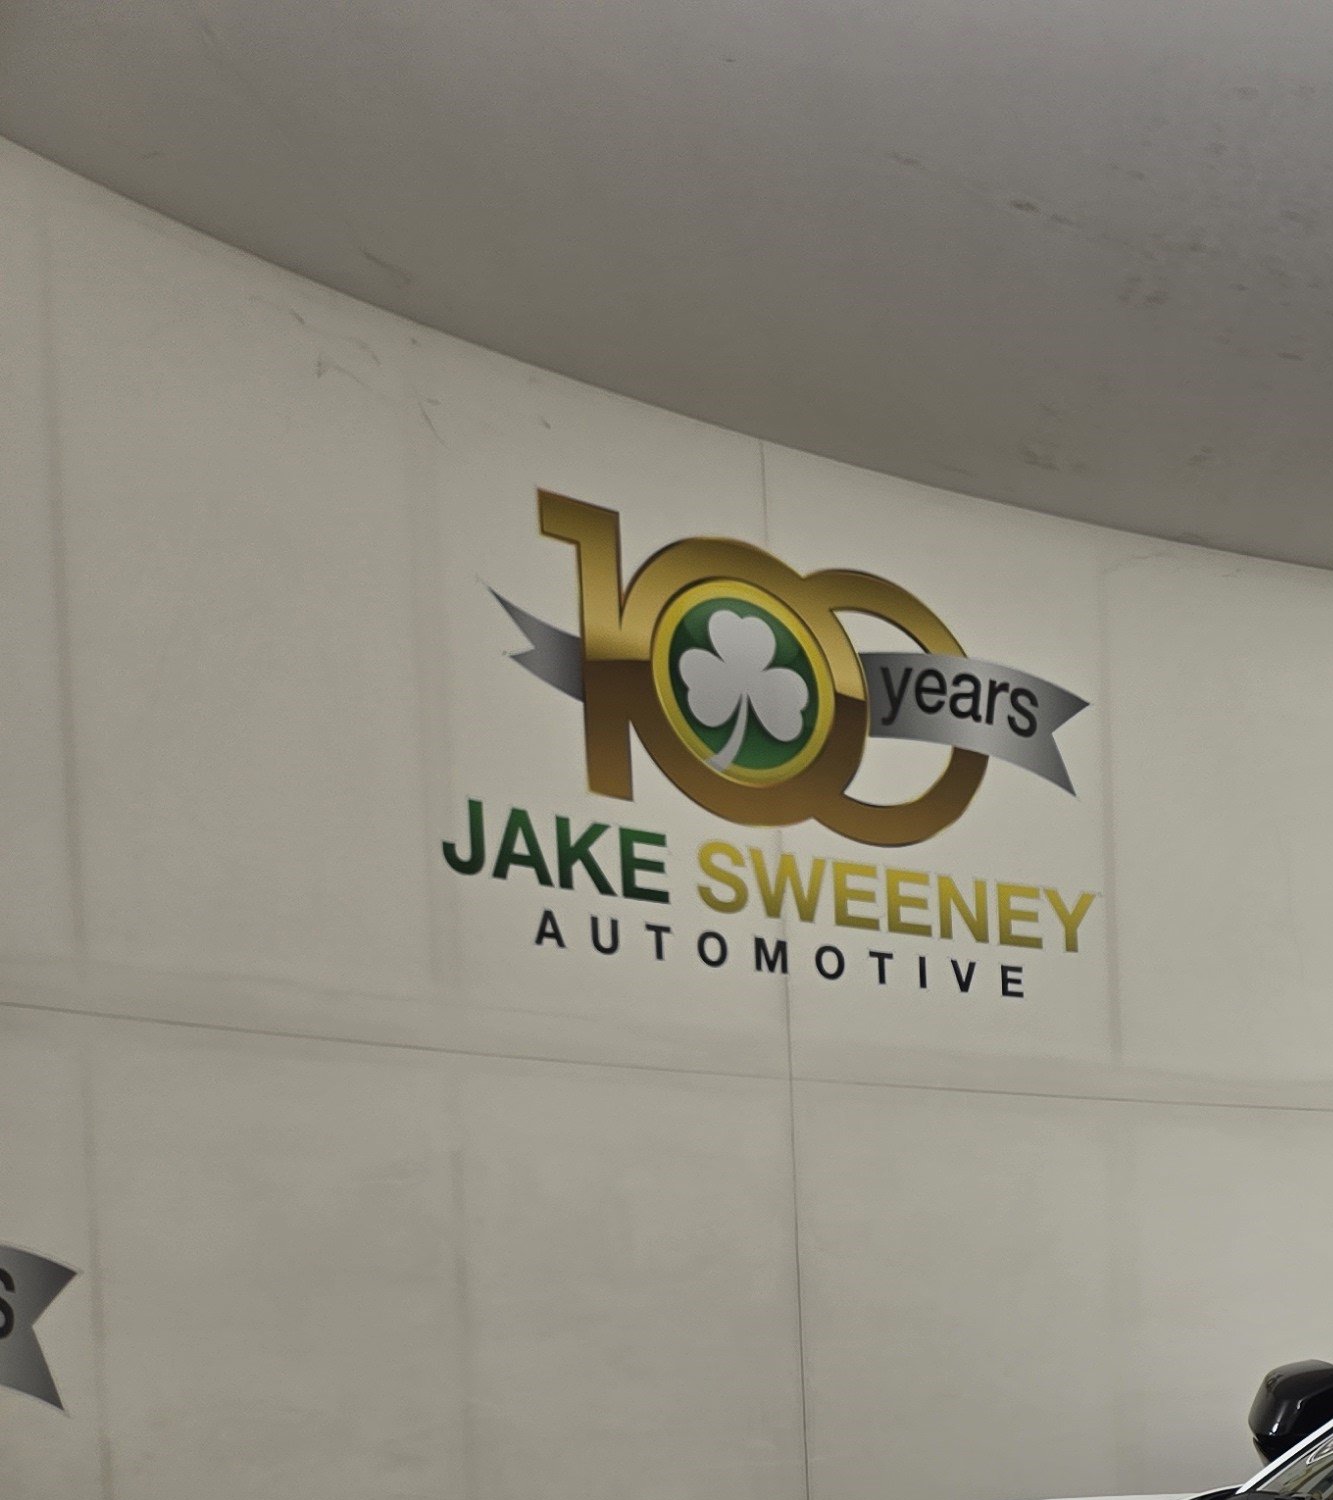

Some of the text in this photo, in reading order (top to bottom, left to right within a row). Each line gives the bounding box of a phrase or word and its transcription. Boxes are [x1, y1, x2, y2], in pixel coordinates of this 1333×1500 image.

[538, 488, 989, 847] 100
[880, 664, 1039, 738] years
[443, 799, 1097, 953] JAKE SWEENEY
[535, 910, 1024, 998] AUTOMOTIVE
